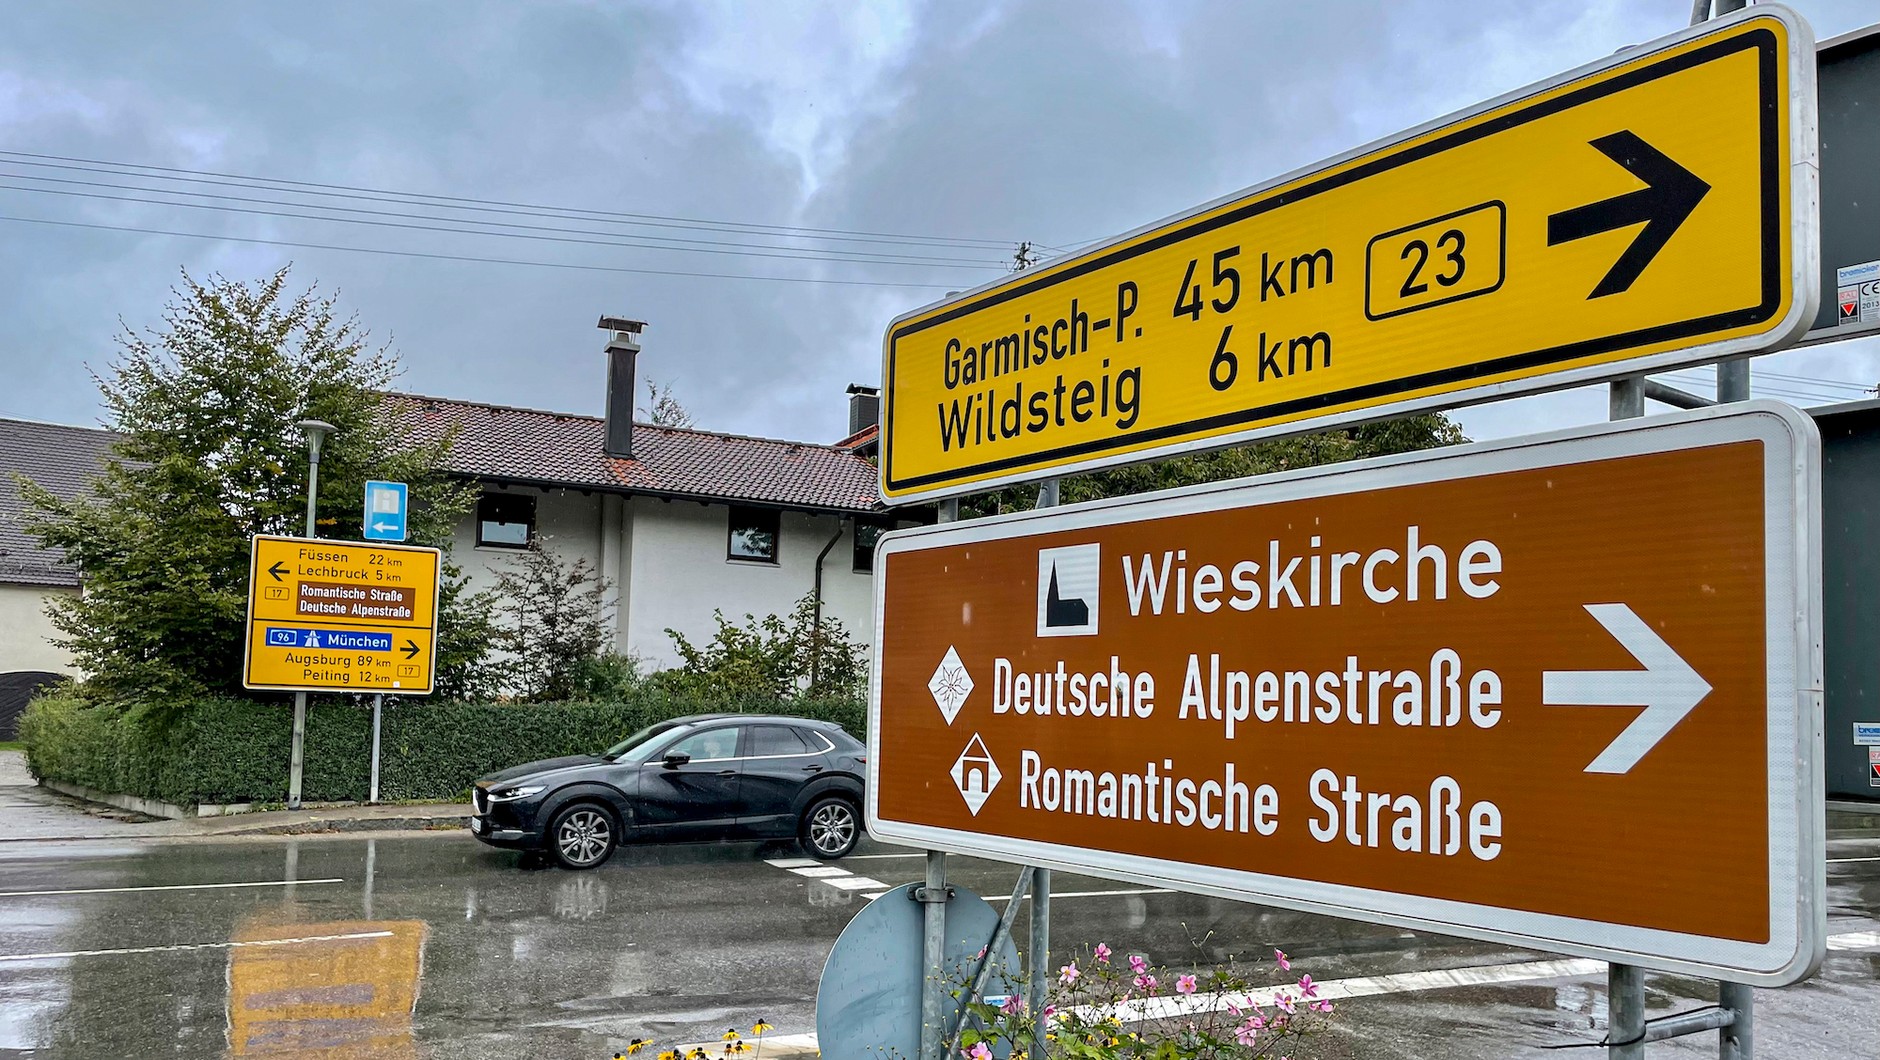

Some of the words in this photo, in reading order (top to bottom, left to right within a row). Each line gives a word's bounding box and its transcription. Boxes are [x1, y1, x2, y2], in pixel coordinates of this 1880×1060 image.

[1400, 229, 1466, 298] 23
[1862, 301, 1880, 309] 2013
[944, 280, 1143, 390] Garmisch-P.
[1173, 245, 1240, 321] 45
[1260, 247, 1334, 302] km
[938, 358, 1141, 453] Wildsteig
[1209, 324, 1239, 391] 6
[1258, 330, 1331, 382] km
[299, 548, 348, 563] Füssen
[369, 553, 384, 566] 22
[387, 557, 403, 567] km
[298, 564, 369, 580] Lechbruck
[376, 570, 383, 581] 5
[386, 572, 402, 582] km
[1121, 526, 1502, 617] Wieskirche
[272, 589, 282, 598] 17
[301, 584, 366, 600] Romantische
[370, 589, 403, 602] Straße
[300, 600, 346, 615] Deutsche
[351, 605, 411, 618] Alpenstraße
[277, 632, 290, 643] 96
[328, 633, 388, 648] München
[285, 652, 351, 668] Augsburg
[357, 656, 373, 667] 89
[376, 658, 391, 668] km
[303, 669, 350, 683] Peiting
[359, 671, 371, 683] 12
[375, 674, 390, 683] km
[404, 667, 414, 675] 17
[993, 655, 1155, 719] Deutsche
[1179, 648, 1502, 739] Alpenstraße
[1020, 750, 1279, 836] Romantische
[1308, 768, 1502, 861] Straße
